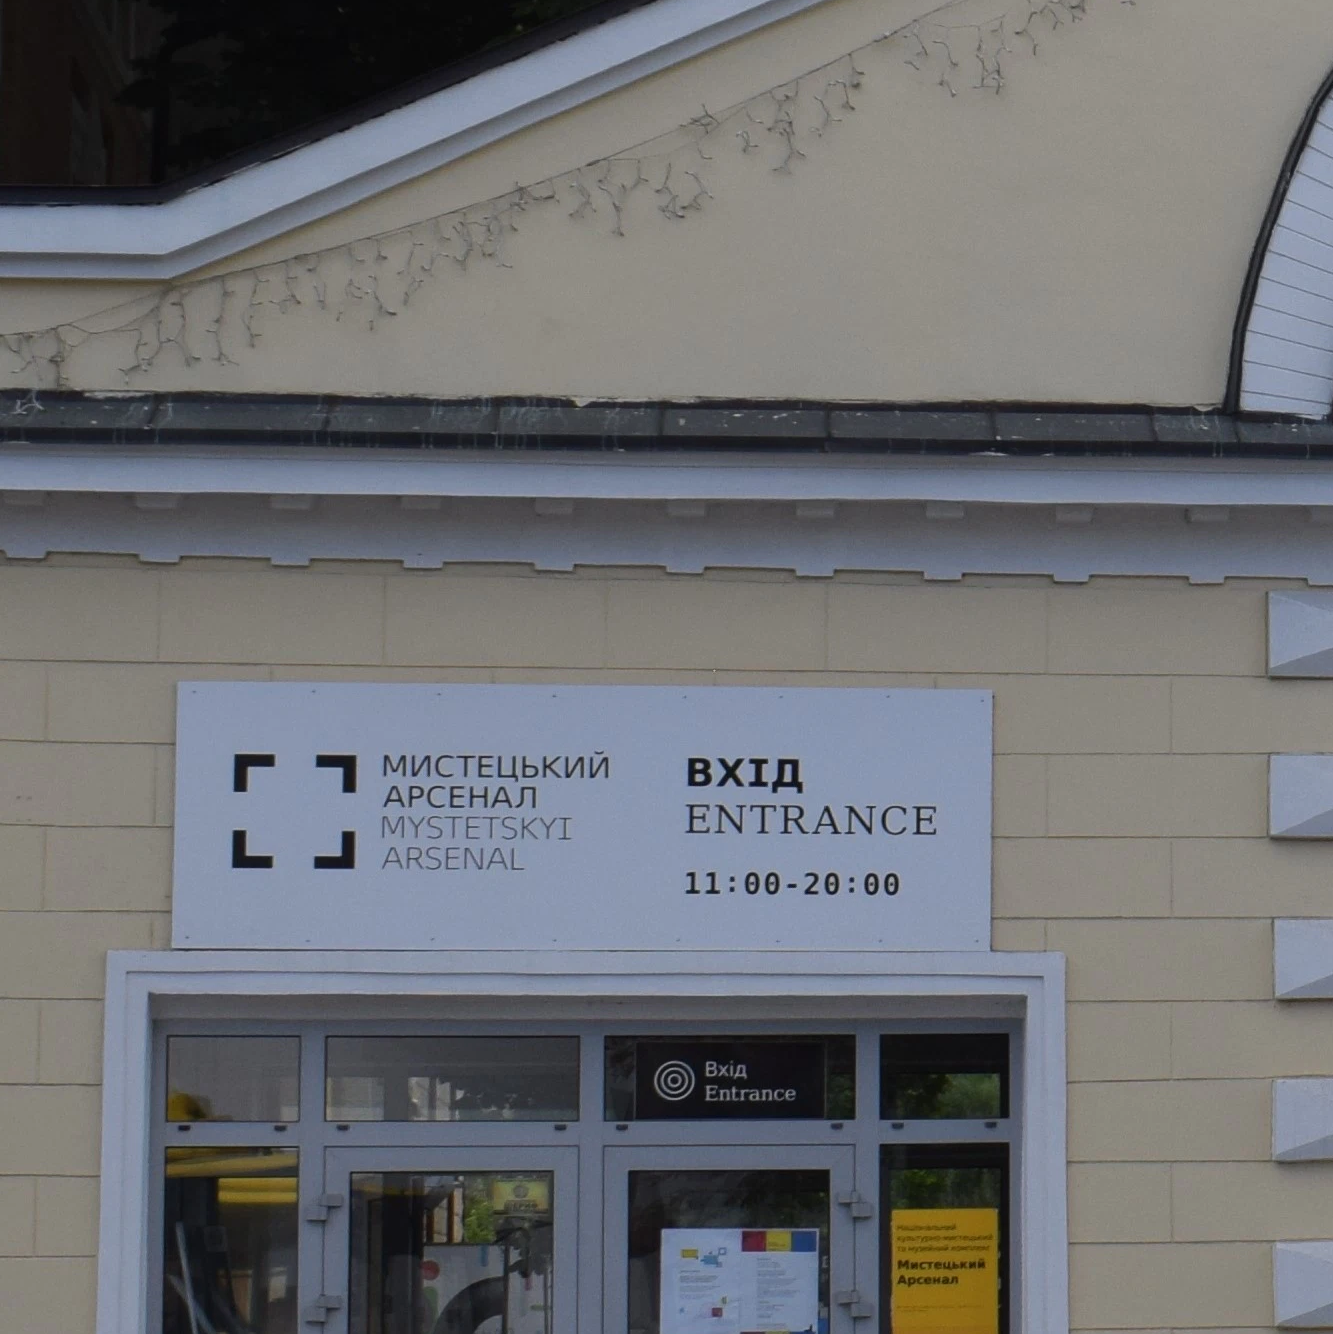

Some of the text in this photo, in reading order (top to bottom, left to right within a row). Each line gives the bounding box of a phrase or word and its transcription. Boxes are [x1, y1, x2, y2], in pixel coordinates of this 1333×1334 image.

[383, 751, 610, 782] МИСТЕЦЬКИЙ
[687, 758, 803, 793] ВХІД
[383, 784, 537, 809] АРСЕНАЛ
[382, 816, 573, 841] MYSTETSKYI
[685, 803, 938, 836] ENTRANCE
[382, 846, 525, 871] ARSENAL
[685, 871, 901, 896] 11:00-20:00
[705, 1061, 748, 1079] Вхід
[705, 1085, 797, 1101] Entrance
[897, 1258, 986, 1271] Мистецький
[897, 1274, 959, 1288] Арсенал
